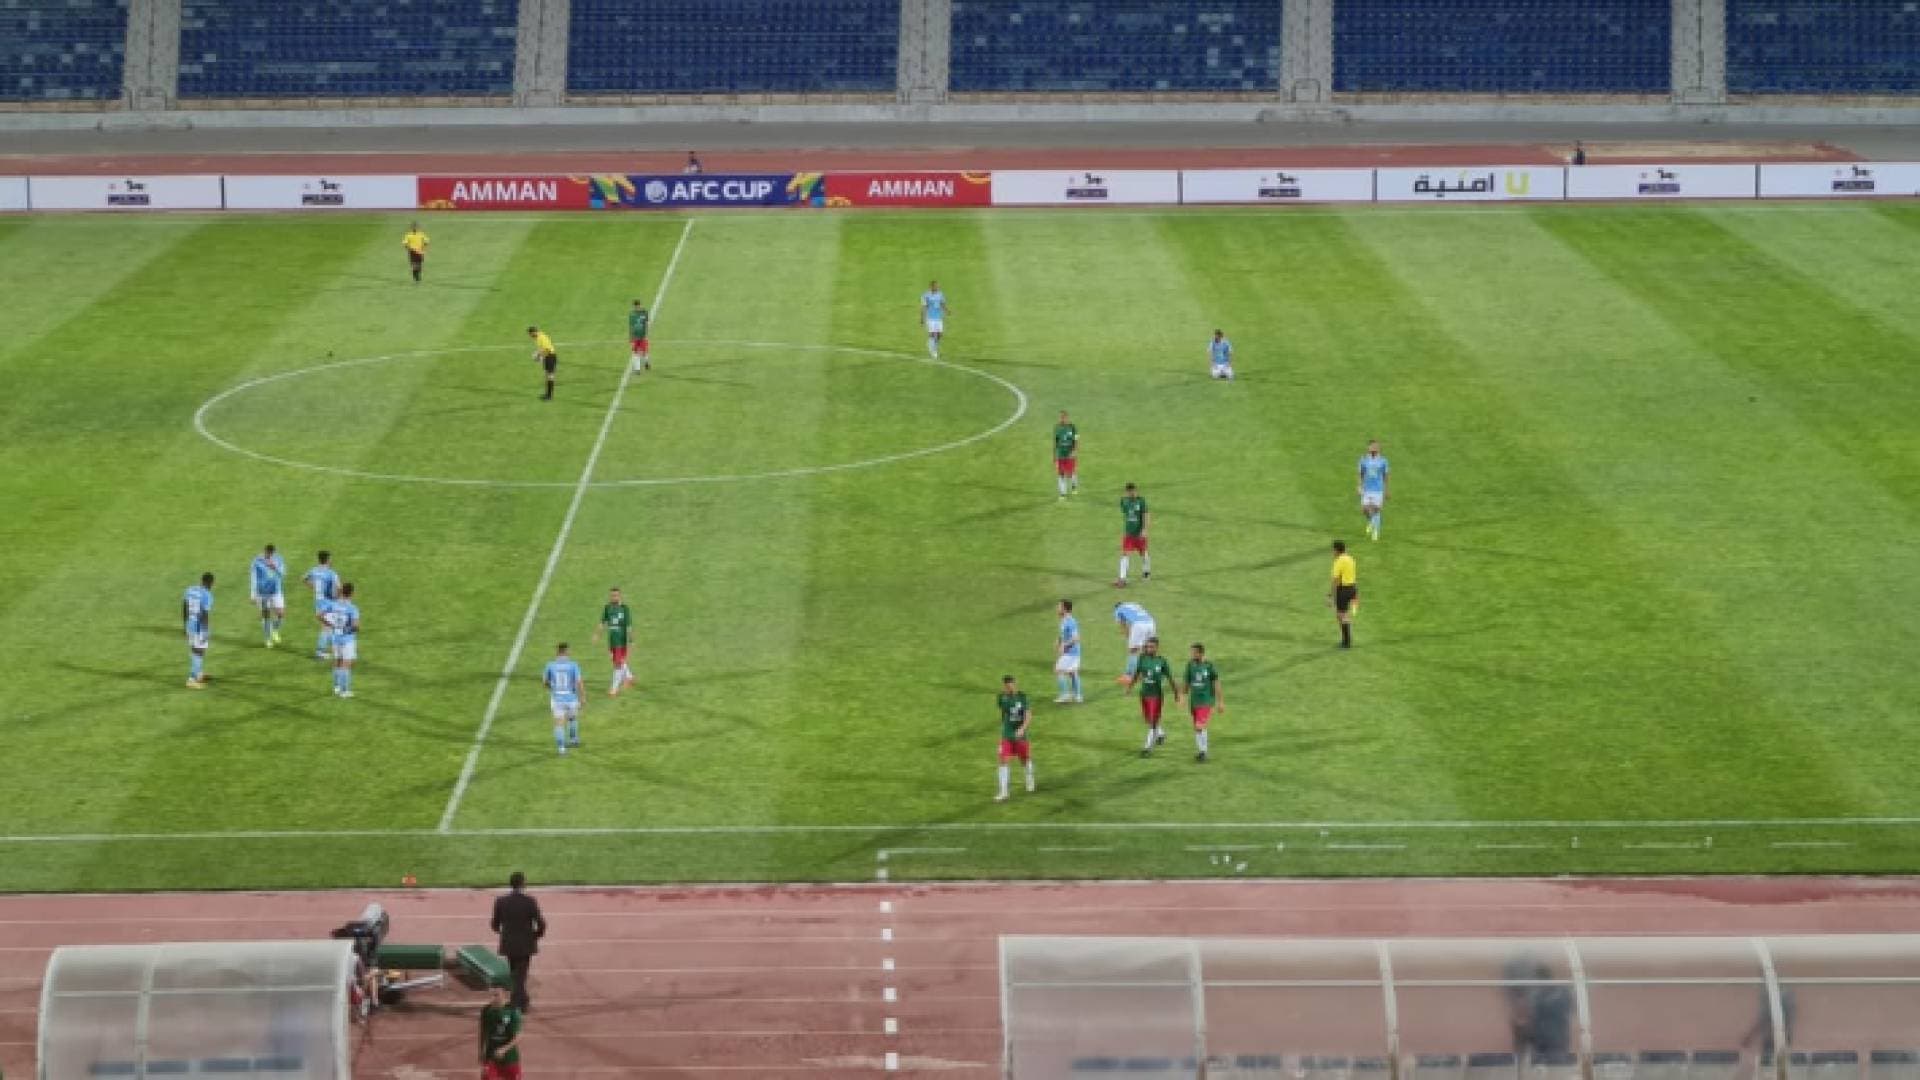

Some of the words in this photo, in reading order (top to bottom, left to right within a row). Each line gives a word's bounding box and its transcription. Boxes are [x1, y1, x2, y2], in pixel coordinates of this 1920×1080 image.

[452, 180, 557, 201] AMMAN
[672, 180, 718, 199] AFC
[722, 180, 772, 199] CUP
[868, 179, 954, 198] AMMAN
